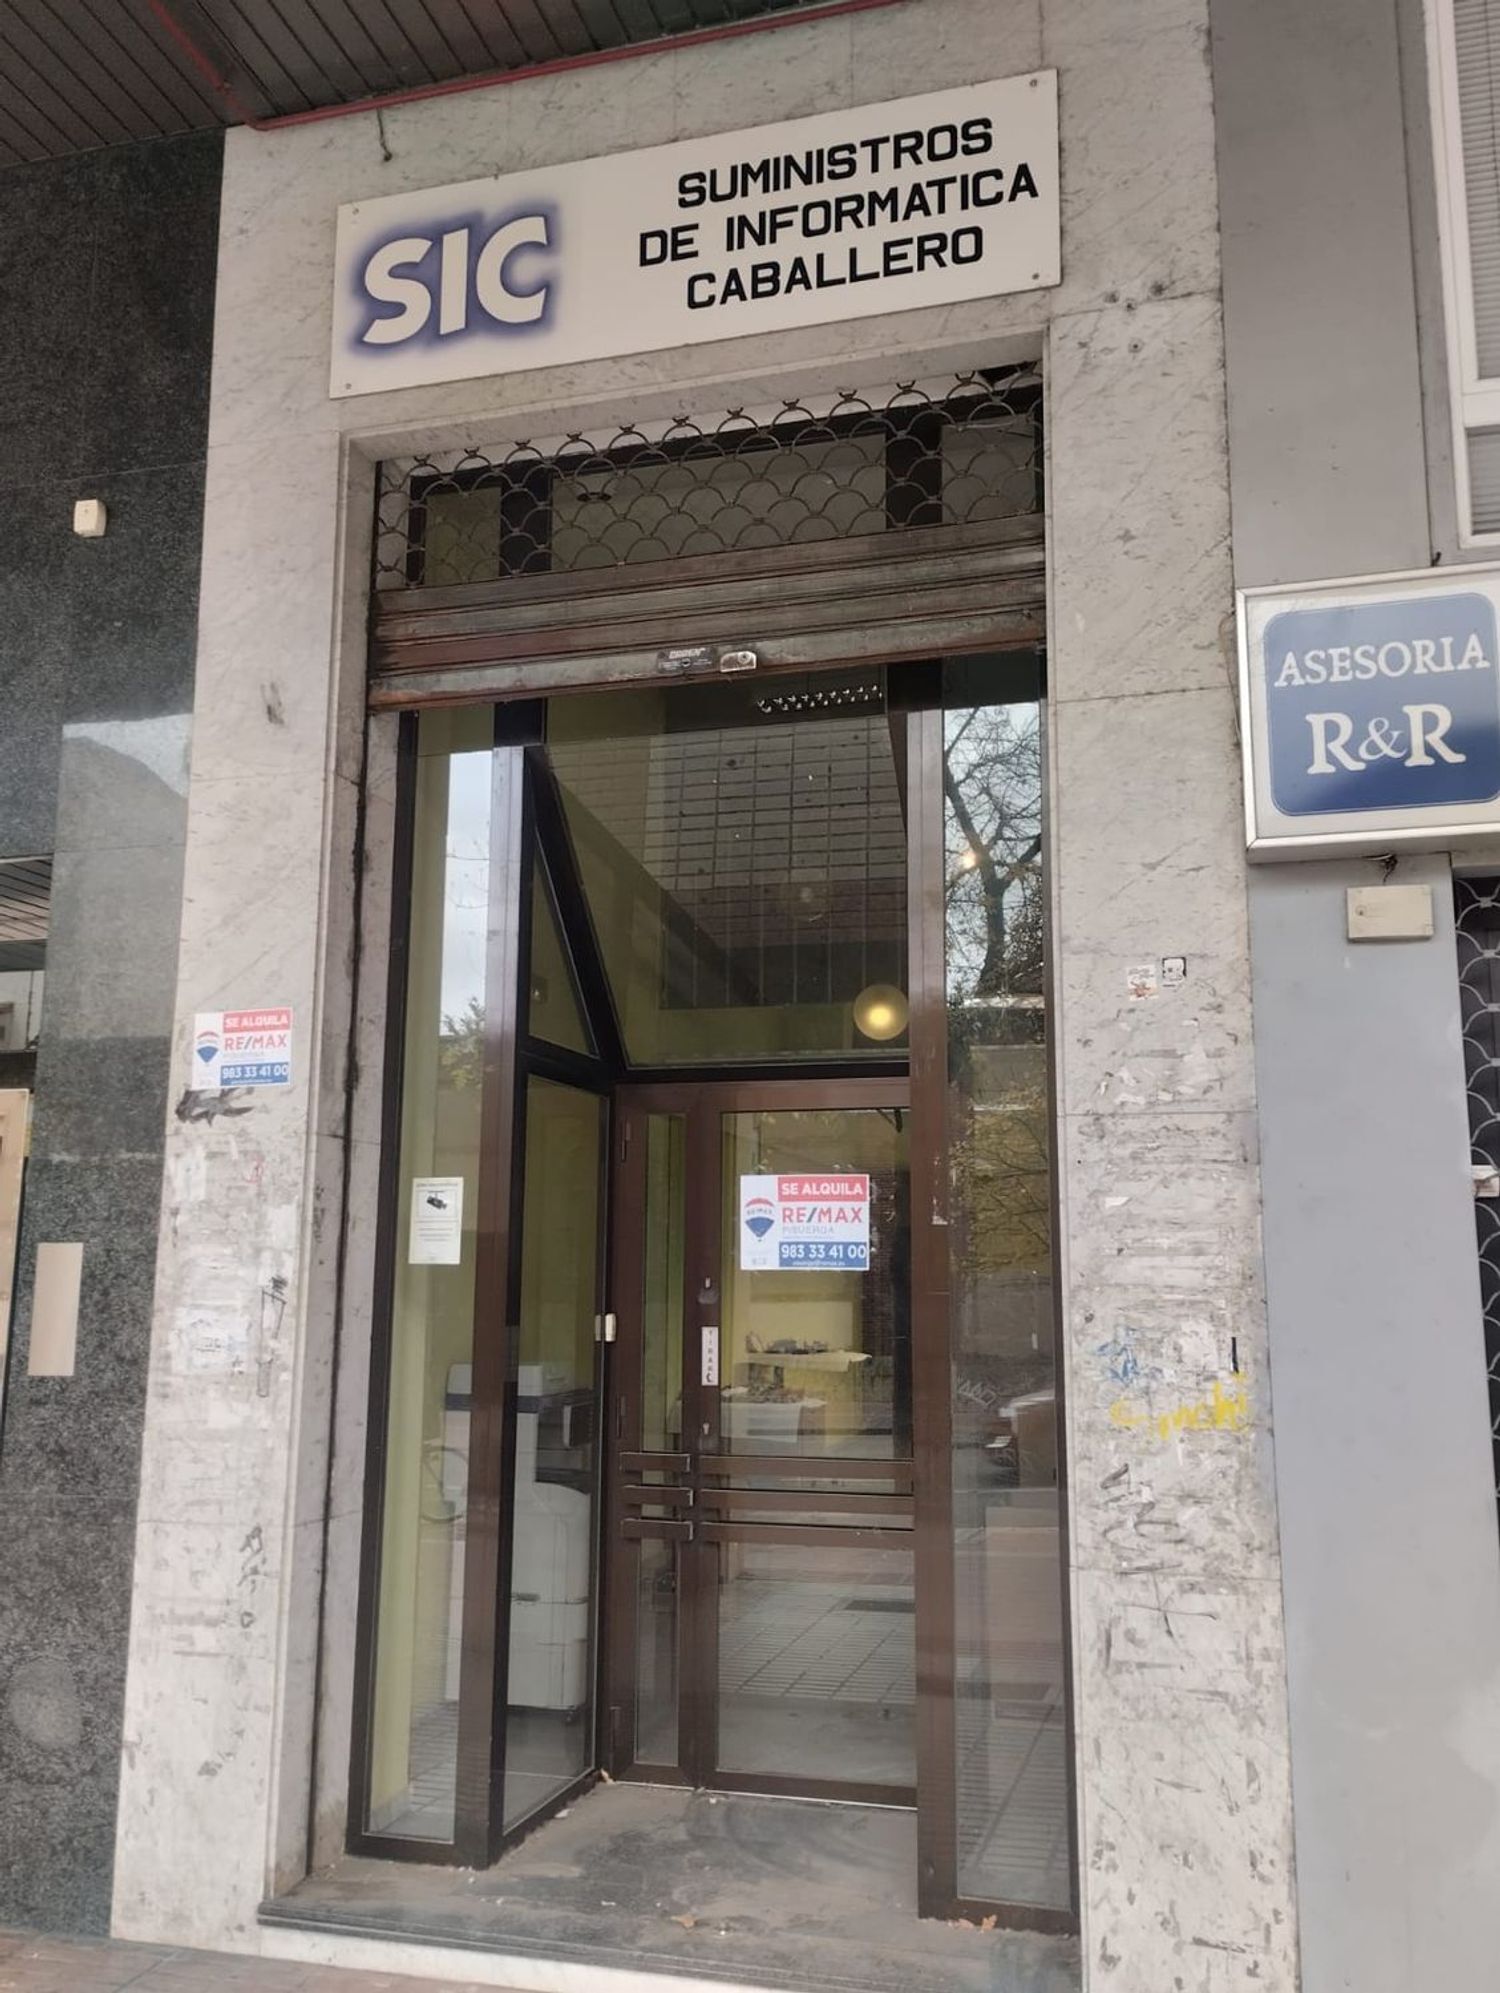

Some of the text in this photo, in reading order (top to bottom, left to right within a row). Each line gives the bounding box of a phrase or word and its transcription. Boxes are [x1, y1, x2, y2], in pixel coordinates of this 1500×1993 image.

[677, 117, 993, 208] SUMINISTROS
[639, 163, 1038, 267] DE INFORMATICA
[363, 216, 549, 344] SIC
[687, 226, 984, 309] CABALLERO
[1274, 633, 1491, 687] ASESORIA
[1305, 704, 1466, 774] R&R
[224, 1014, 288, 1029] SE ALQUILA
[224, 1034, 287, 1050] RE/MAX
[244, 1066, 257, 1078] 33
[259, 1064, 271, 1076] 41
[273, 1063, 288, 1075] 00
[781, 1182, 864, 1197] SE ALQUILA
[781, 1207, 863, 1223] RE/MAX
[781, 1244, 866, 1258] 983 33 41 00
